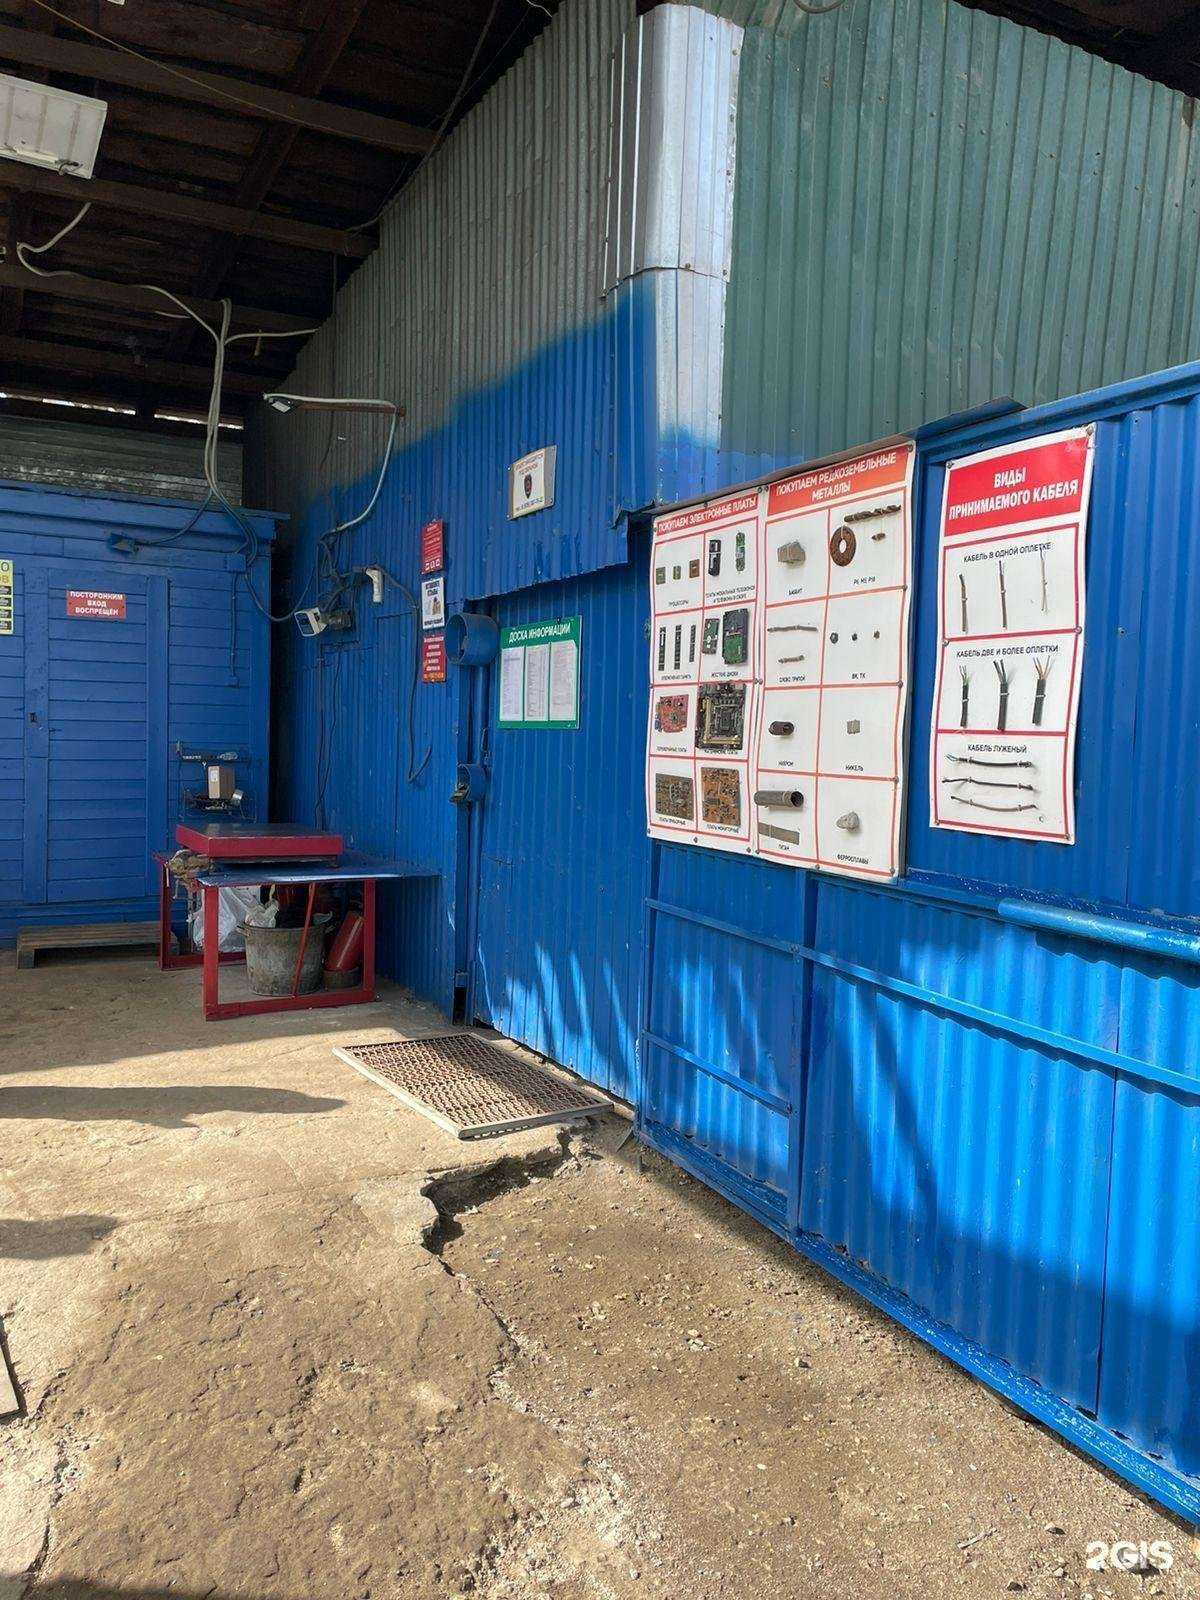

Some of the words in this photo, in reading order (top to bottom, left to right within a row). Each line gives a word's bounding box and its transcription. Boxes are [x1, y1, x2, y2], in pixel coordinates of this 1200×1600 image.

[777, 475, 818, 496] ПОКУПАЕМ
[819, 452, 896, 485] РЕДКОЗЕМЕЛЬНЫЕ
[994, 468, 1026, 488] ВИДЫ
[812, 480, 851, 500] МЕТАЛЛЫ
[949, 489, 1030, 520] ПРИНИМАЕМОГО
[1032, 480, 1079, 503] КАБЕЛЯ
[658, 516, 689, 532] ПОКУПАЕМ
[689, 504, 731, 524] ЭЛЕКТРОННЫЕ
[732, 497, 756, 512] ПЛАТЫ
[964, 553, 987, 563] КАБЕЛЬ
[995, 546, 1018, 558] ОДНОЙ
[1020, 542, 1052, 553] ОПЛЕТКЕ
[70, 591, 123, 601] ПОСТОРОННИМ
[87, 600, 107, 608] ВХОД
[75, 607, 119, 616] ВОСПРЕЩЕН
[509, 630, 528, 644] ДОСКА
[529, 623, 571, 639] ИНФОРМАЦИИ
[956, 649, 980, 658] КАБЕЛЬ
[981, 648, 994, 657] ДВЕ
[1002, 646, 1024, 655] БОЛЕЕ
[1025, 645, 1058, 654] ОПЛЕТКИ
[993, 745, 1027, 753] ЛУЖЕНЫЙ
